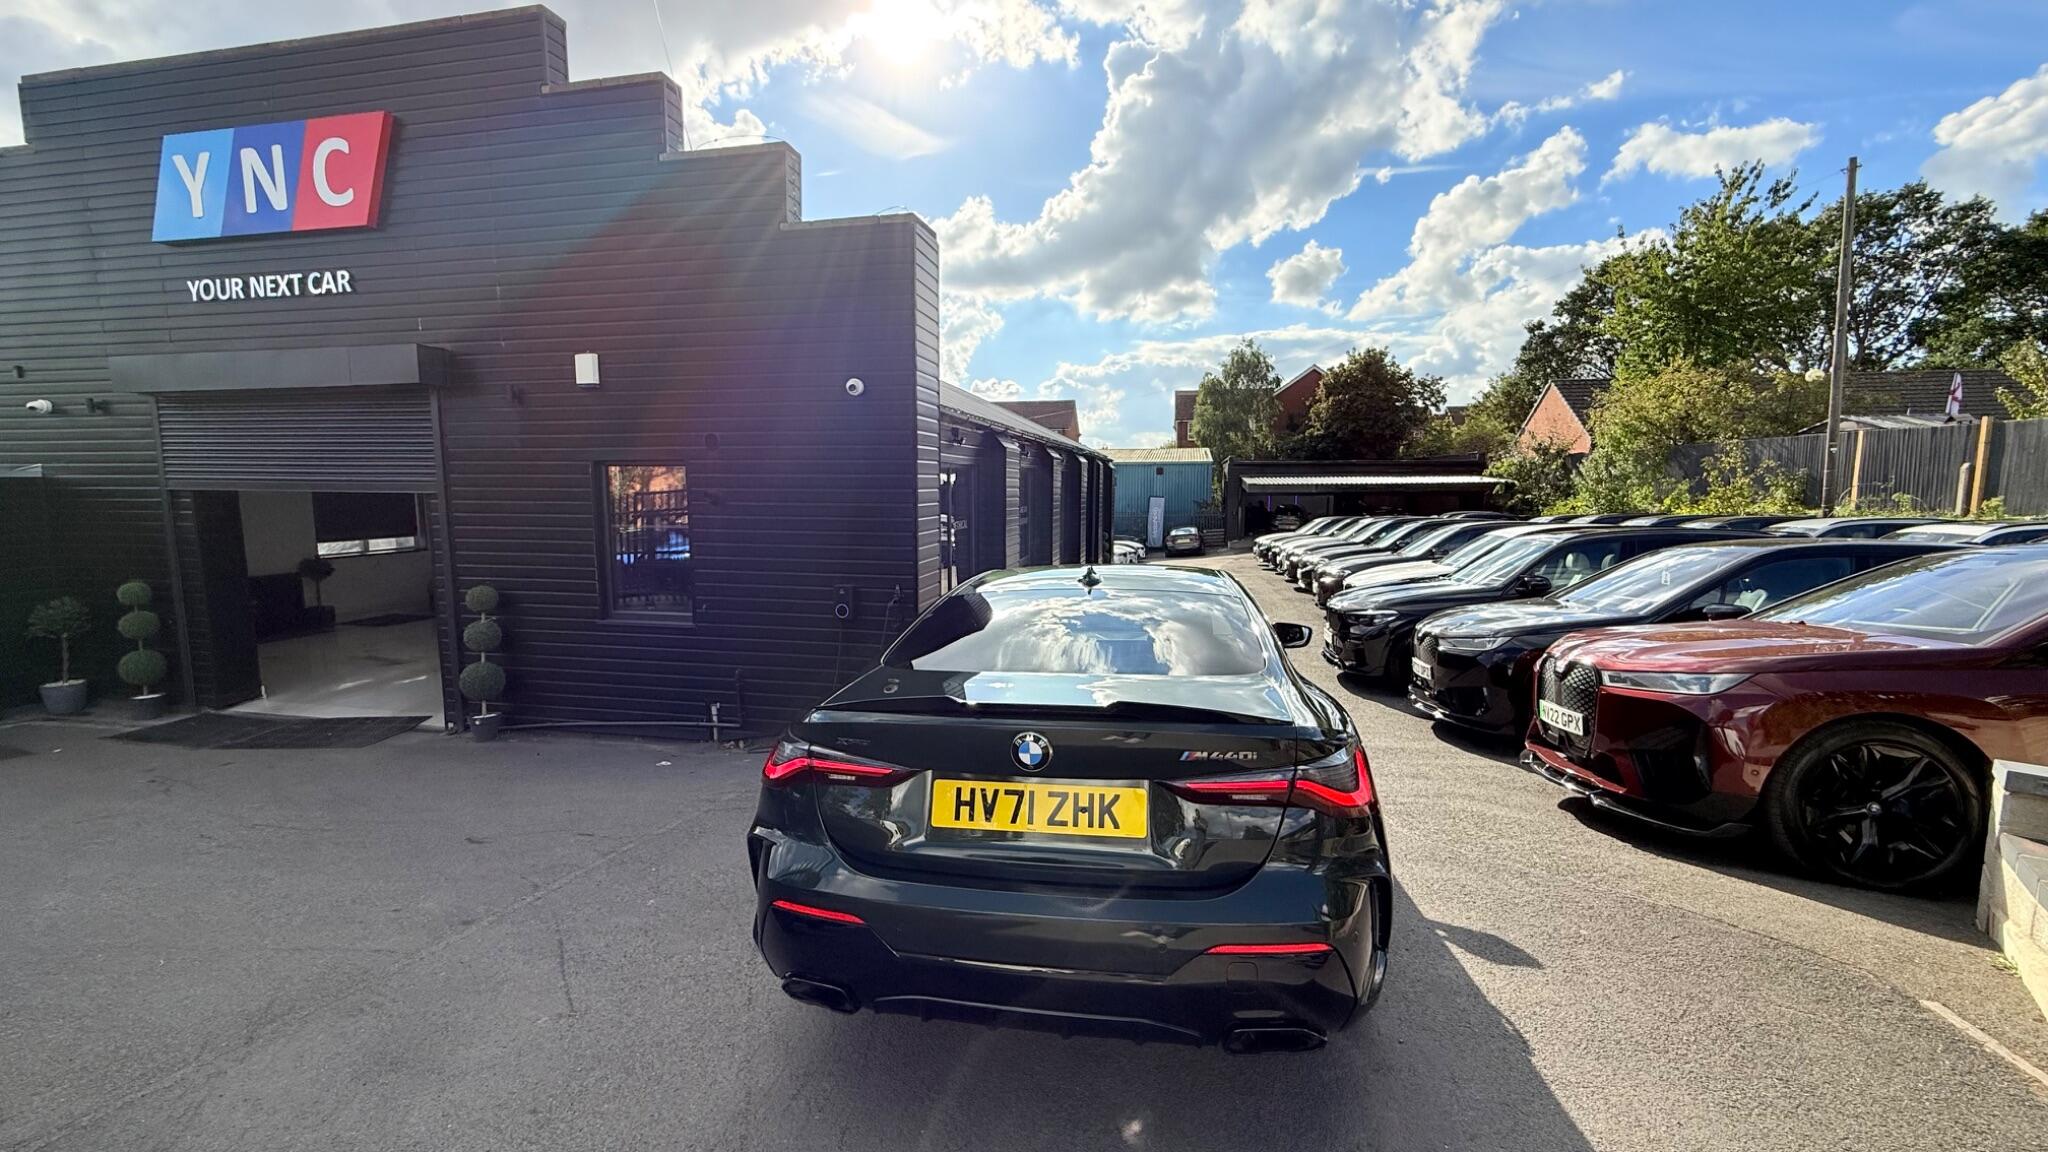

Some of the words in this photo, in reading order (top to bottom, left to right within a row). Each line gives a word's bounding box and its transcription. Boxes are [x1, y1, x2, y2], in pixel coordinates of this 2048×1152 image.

[172, 137, 354, 218] YNC
[187, 277, 245, 302] YOUR
[249, 274, 302, 299] NEXT
[307, 270, 352, 295] CAR
[1561, 711, 1581, 732] GPX
[1015, 734, 1047, 748] BMW
[954, 786, 1035, 825] HV71
[1046, 790, 1121, 830] ZHK
